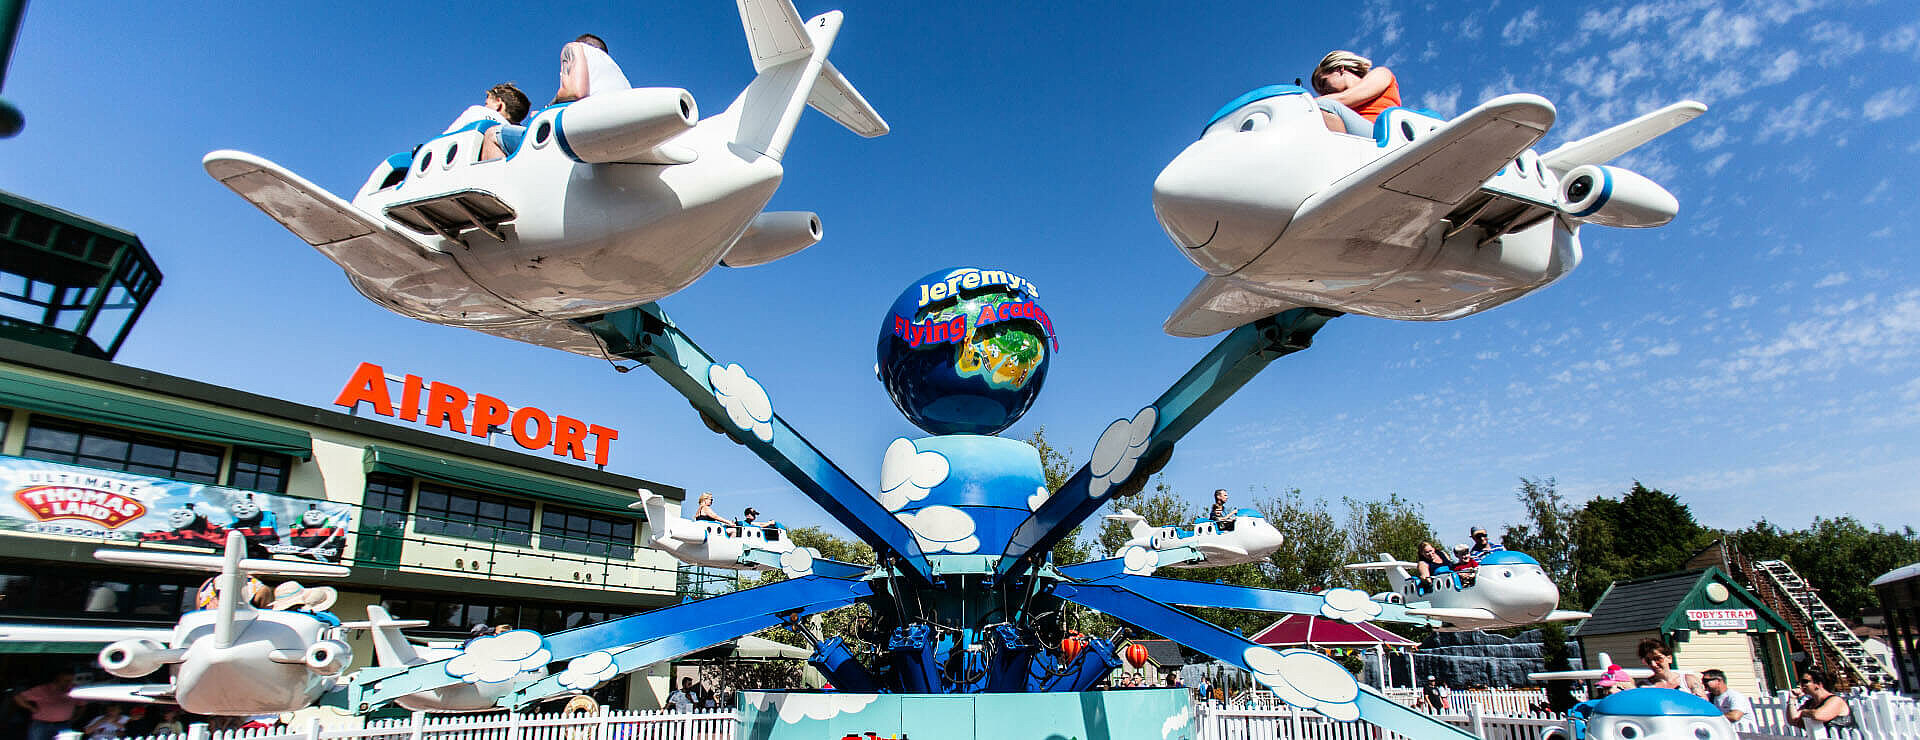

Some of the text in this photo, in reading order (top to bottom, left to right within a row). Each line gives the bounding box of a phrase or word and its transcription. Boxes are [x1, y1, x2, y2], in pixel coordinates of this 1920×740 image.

[820, 17, 826, 28] 2
[918, 270, 1040, 308] Jeremy's
[895, 312, 967, 348] Flying
[334, 362, 618, 466] AIRPORT
[30, 473, 139, 496] ULTIMATE
[24, 487, 140, 517] THOMAS
[51, 501, 112, 520] LAND
